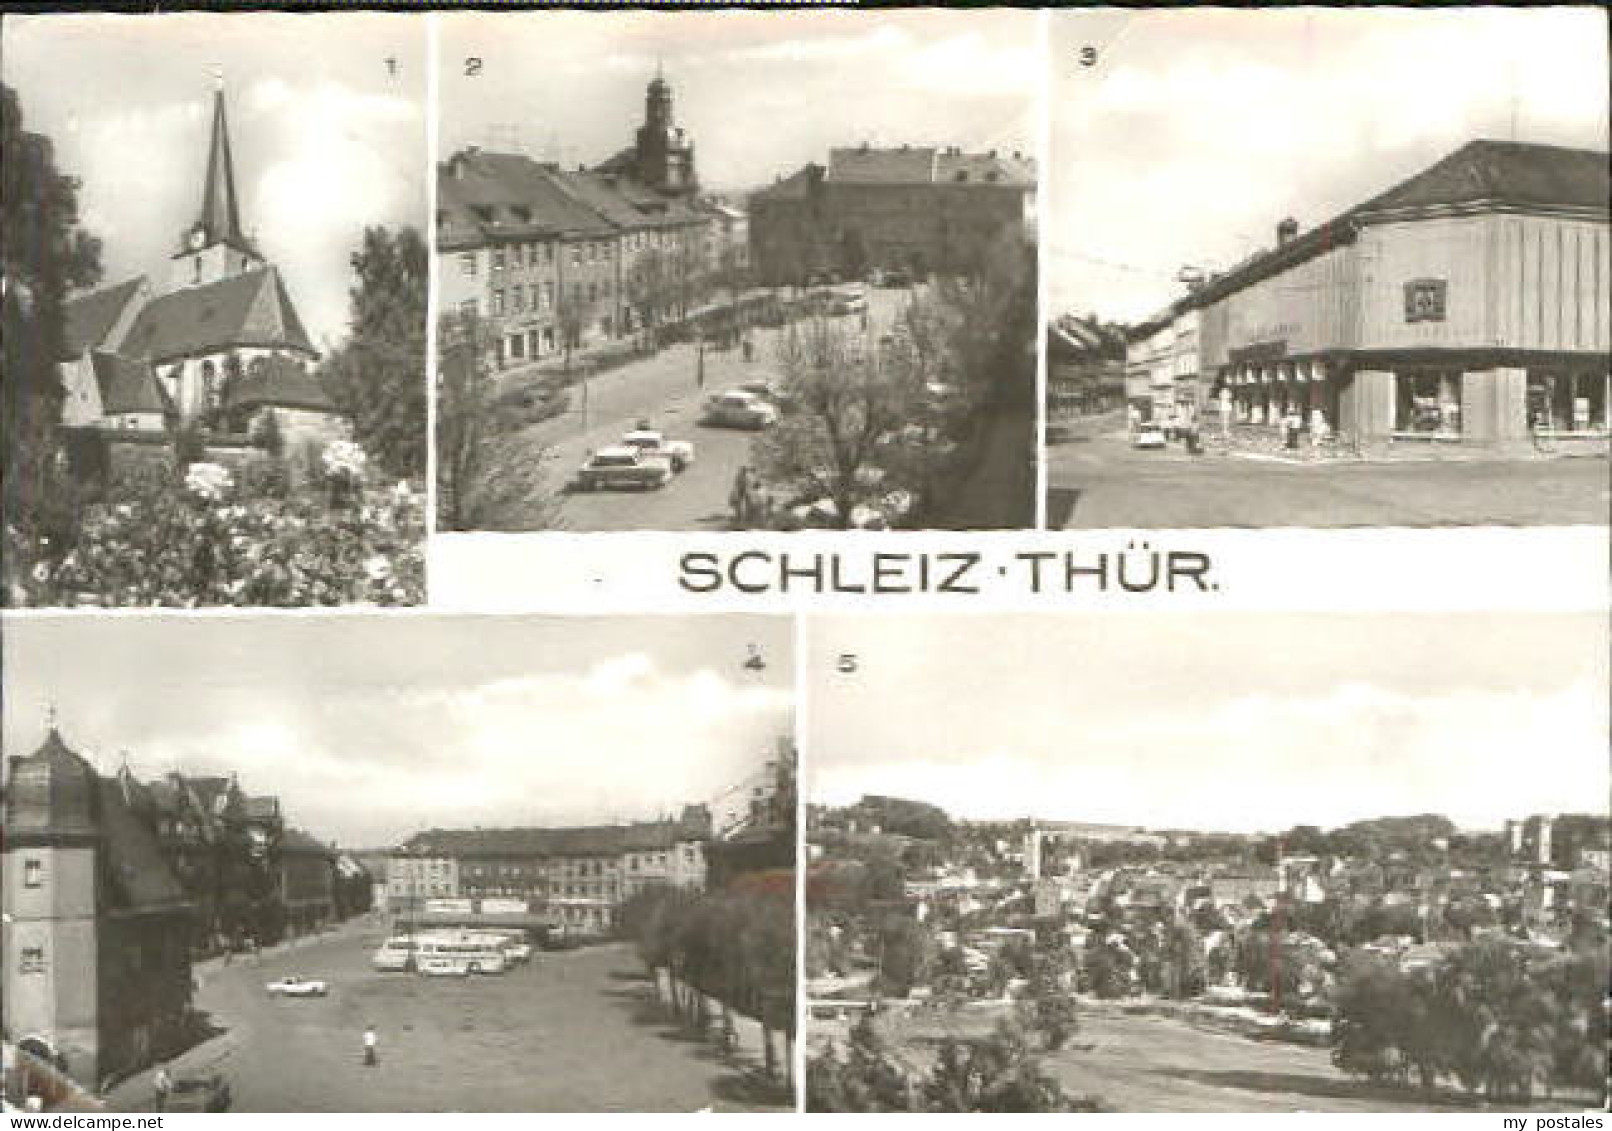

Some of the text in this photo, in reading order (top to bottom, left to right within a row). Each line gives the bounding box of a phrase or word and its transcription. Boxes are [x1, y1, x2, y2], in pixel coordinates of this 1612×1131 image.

[384, 57, 396, 76] 1
[464, 57, 482, 76] 2
[1079, 47, 1098, 67] 3
[678, 542, 1219, 593] SCHLEIZ THÜR.
[743, 653, 767, 672] 4
[838, 654, 857, 673] 5
